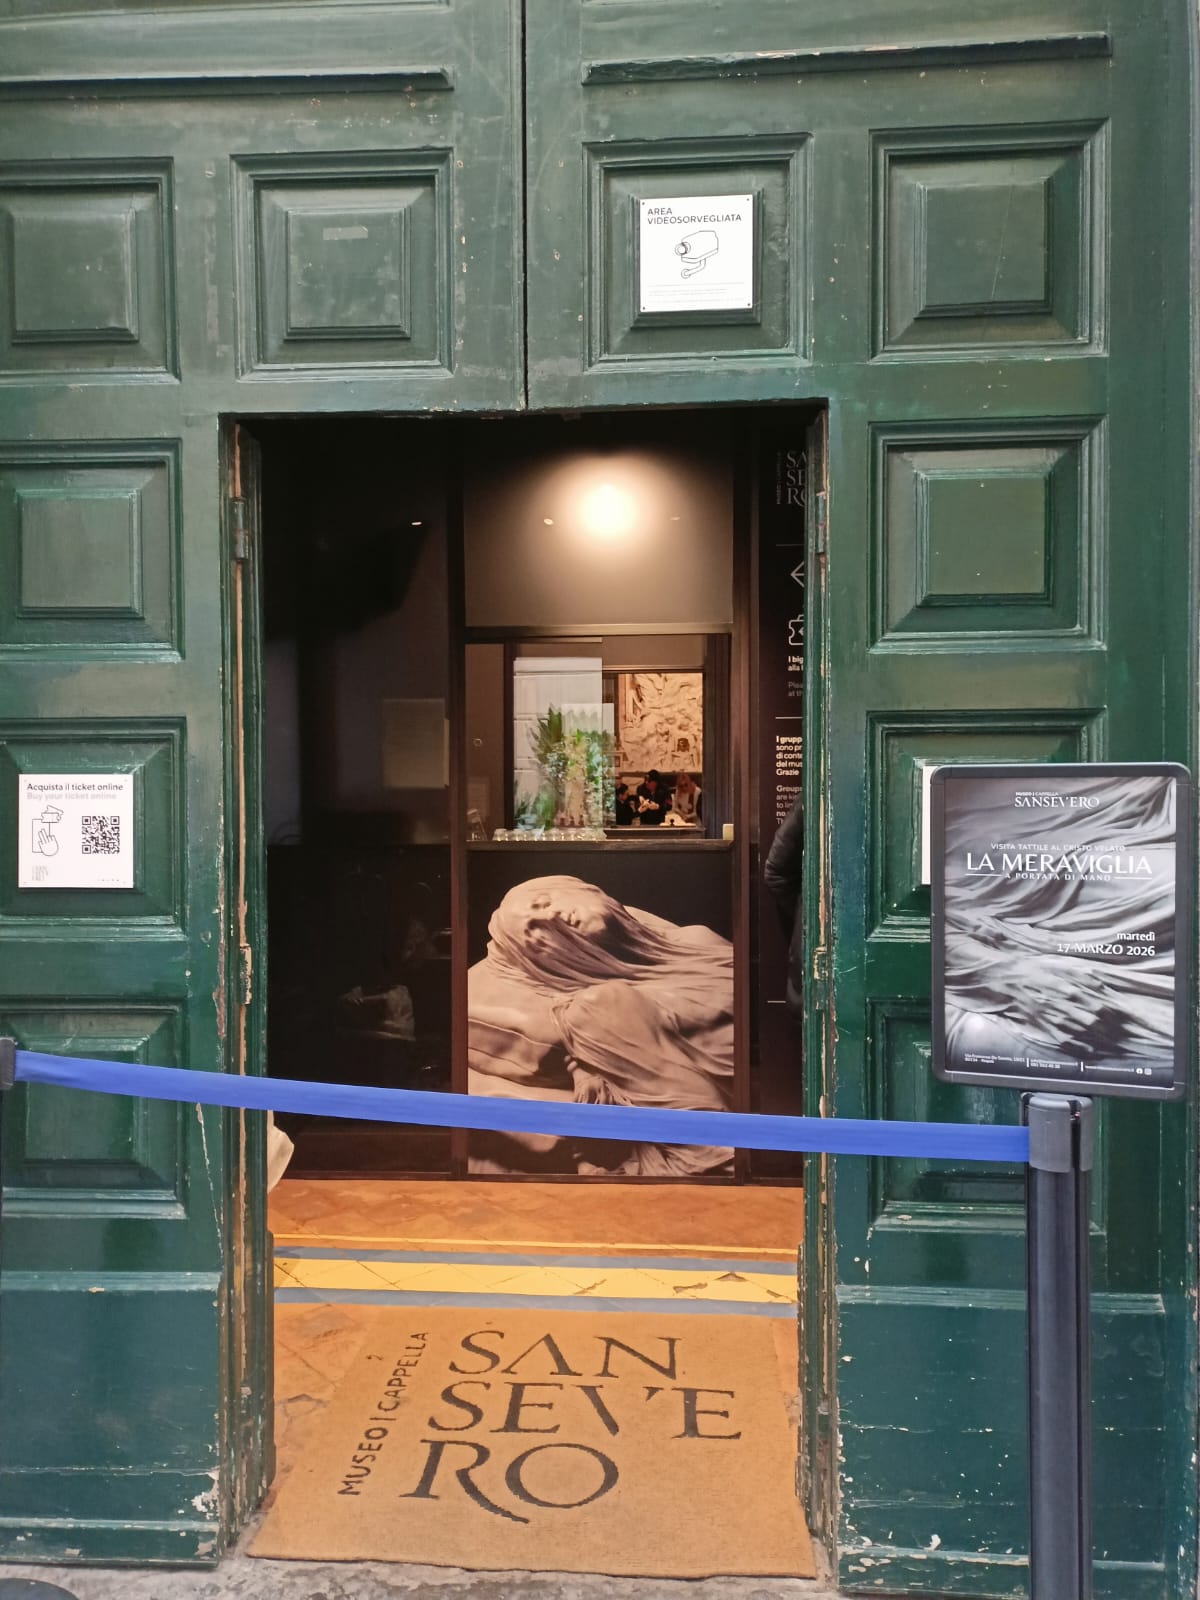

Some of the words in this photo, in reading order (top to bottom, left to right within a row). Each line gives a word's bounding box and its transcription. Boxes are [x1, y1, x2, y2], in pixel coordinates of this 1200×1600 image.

[647, 214, 742, 224] VIDEOSORVEGLIATA
[792, 655, 804, 665] big
[780, 736, 803, 744] grupp
[776, 760, 787, 768] del
[776, 768, 800, 776] Grazie
[27, 783, 63, 792] Acquista
[27, 792, 42, 800] Buy
[1014, 796, 1100, 809] SANSEVERO
[1063, 844, 1091, 852] CRISTO
[967, 852, 995, 871] LA
[1002, 853, 1152, 874] MERAVIGLIA
[1015, 873, 1060, 881] PORTATA
[1080, 874, 1112, 882] MANO
[1117, 931, 1155, 941] martedì
[1057, 943, 1069, 953] 17
[1073, 943, 1123, 955] MARZO
[1126, 945, 1156, 956] 2026
[449, 1330, 682, 1380] SAN
[337, 1426, 390, 1496] MUSEO
[377, 1332, 429, 1414] CAPPELLA
[398, 1439, 620, 1524] RO
